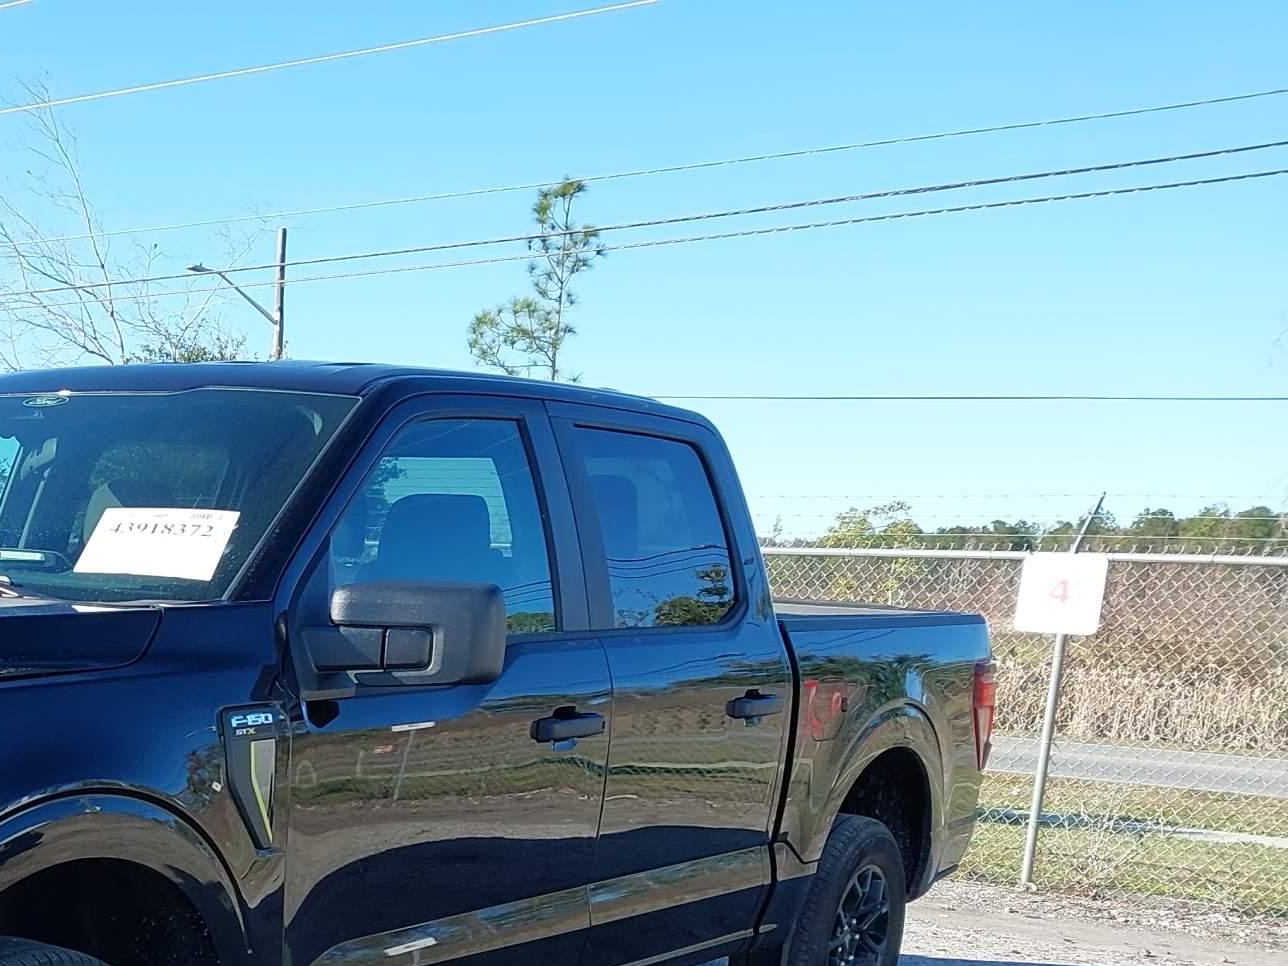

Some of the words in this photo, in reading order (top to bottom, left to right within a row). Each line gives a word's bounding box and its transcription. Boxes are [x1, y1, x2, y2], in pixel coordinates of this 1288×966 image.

[109, 522, 214, 537] 43918372
[1048, 580, 1071, 603] 4
[231, 713, 273, 728] F-150
[235, 728, 256, 736] STX
